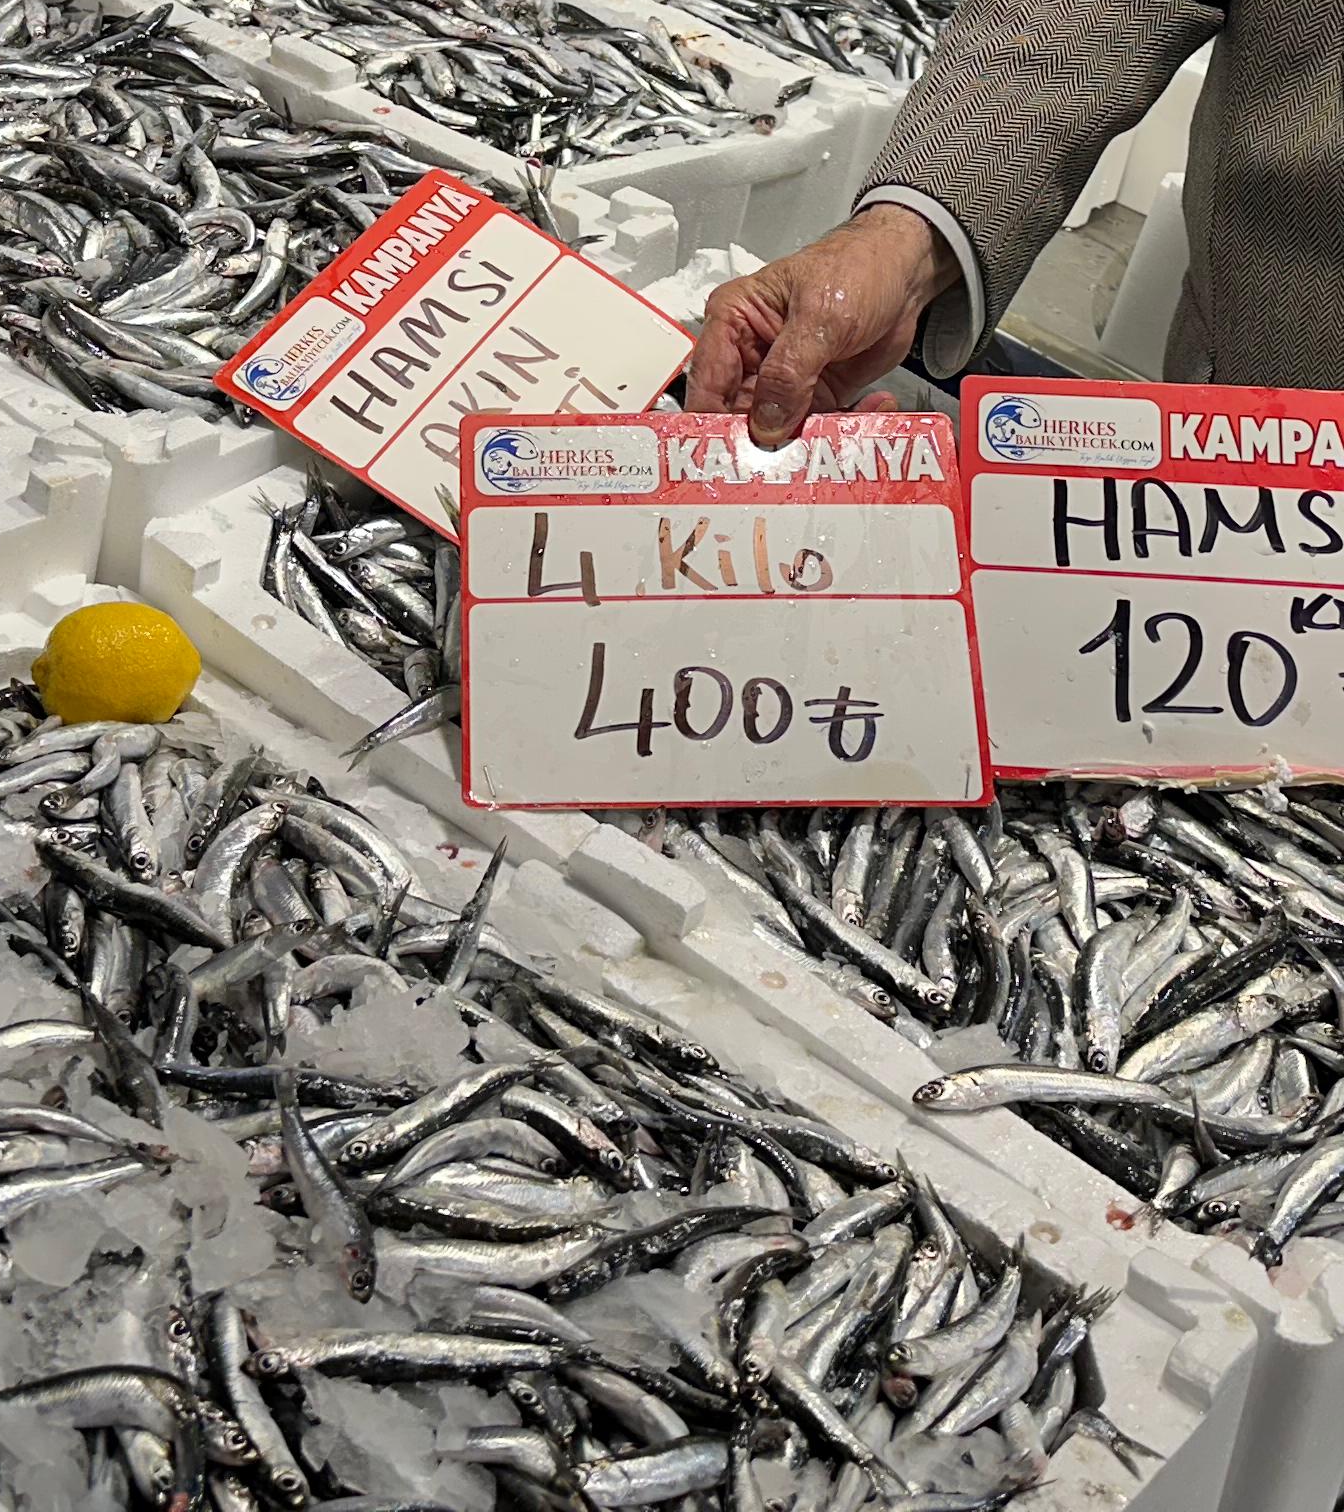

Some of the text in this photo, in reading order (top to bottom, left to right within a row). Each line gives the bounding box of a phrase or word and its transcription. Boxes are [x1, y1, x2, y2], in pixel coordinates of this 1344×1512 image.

[331, 182, 480, 316] KAMPANYA
[329, 249, 514, 434] HAMSİ
[540, 449, 614, 464] HERKES
[1015, 434, 1154, 451] BALIK YİYECEK.COM
[1043, 419, 1116, 436] HERKES
[527, 512, 833, 606] 4 Kilo
[1078, 598, 1298, 726] 120
